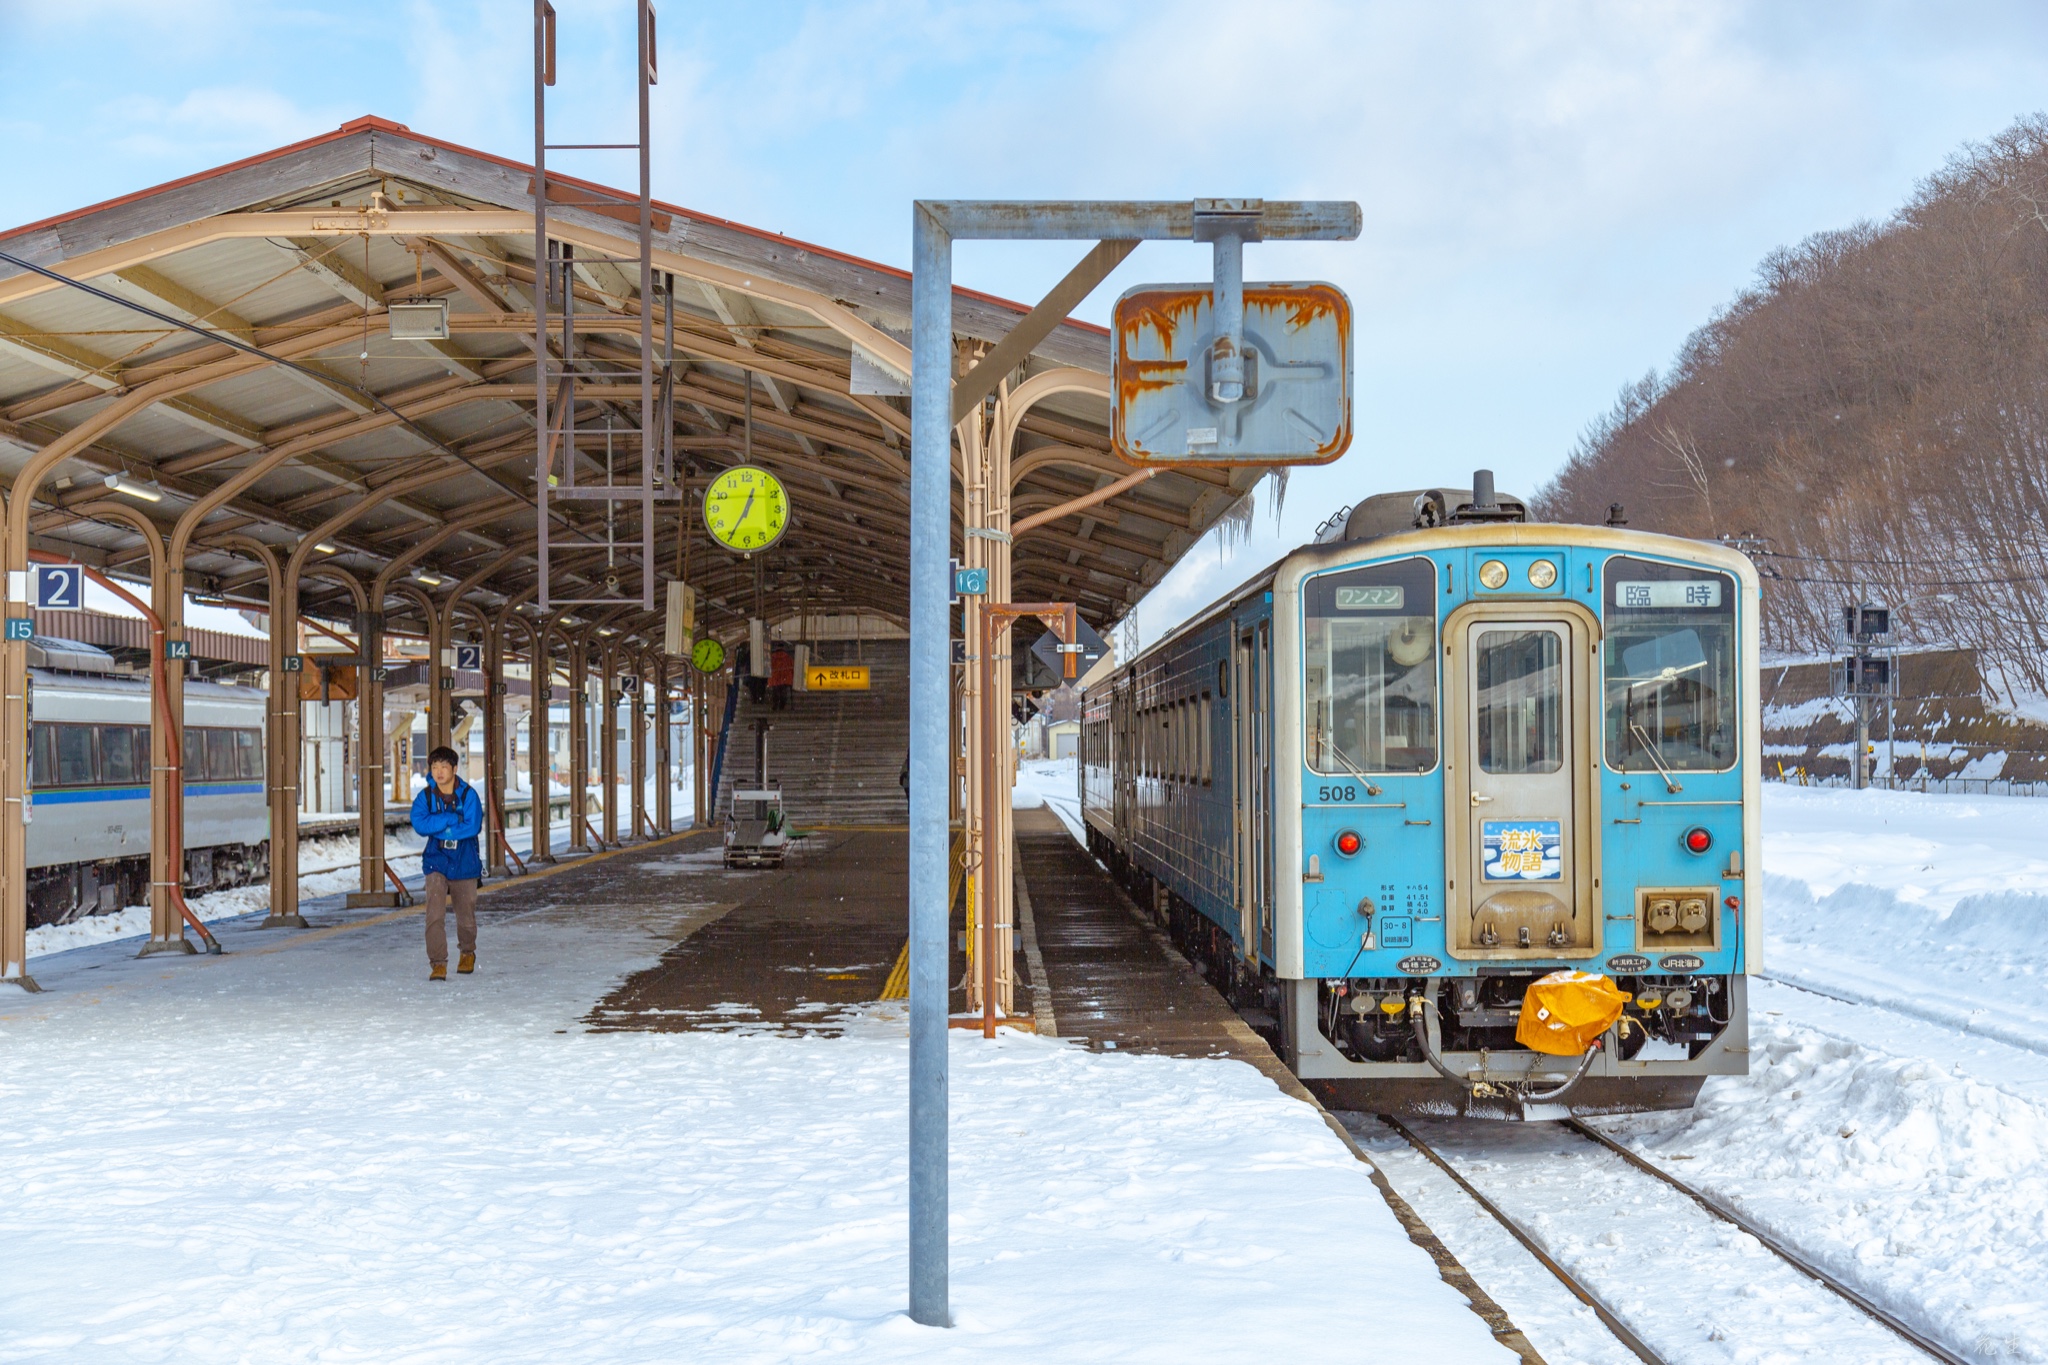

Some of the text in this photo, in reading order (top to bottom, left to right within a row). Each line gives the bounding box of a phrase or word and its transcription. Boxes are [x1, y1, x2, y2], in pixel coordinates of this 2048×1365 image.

[741, 474, 753, 482] 12
[760, 479, 764, 487] 1
[728, 480, 737, 488] 11
[717, 492, 728, 500] 10
[770, 491, 778, 499] 2
[712, 505, 720, 513] 9
[774, 505, 782, 514] 3
[716, 520, 724, 528] 8
[770, 520, 777, 528] 4
[743, 536, 751, 545] 6
[758, 532, 766, 540] 5
[959, 571, 980, 592] 16
[47, 570, 70, 605] 2
[1340, 589, 1398, 604] ワンマン
[11, 621, 32, 639] 15
[171, 643, 188, 658] 14
[462, 647, 475, 668] 2
[284, 657, 300, 671] 13
[373, 669, 387, 681] 12
[829, 670, 860, 680] 改札口
[443, 678, 453, 689] 11
[624, 677, 634, 691] 2
[496, 684, 505, 694] 10
[542, 690, 549, 699] 9
[1319, 785, 1356, 801] 508
[1501, 830, 1542, 850] 流氷
[1501, 852, 1542, 872] 物語
[1663, 959, 1701, 968] JR北海道
